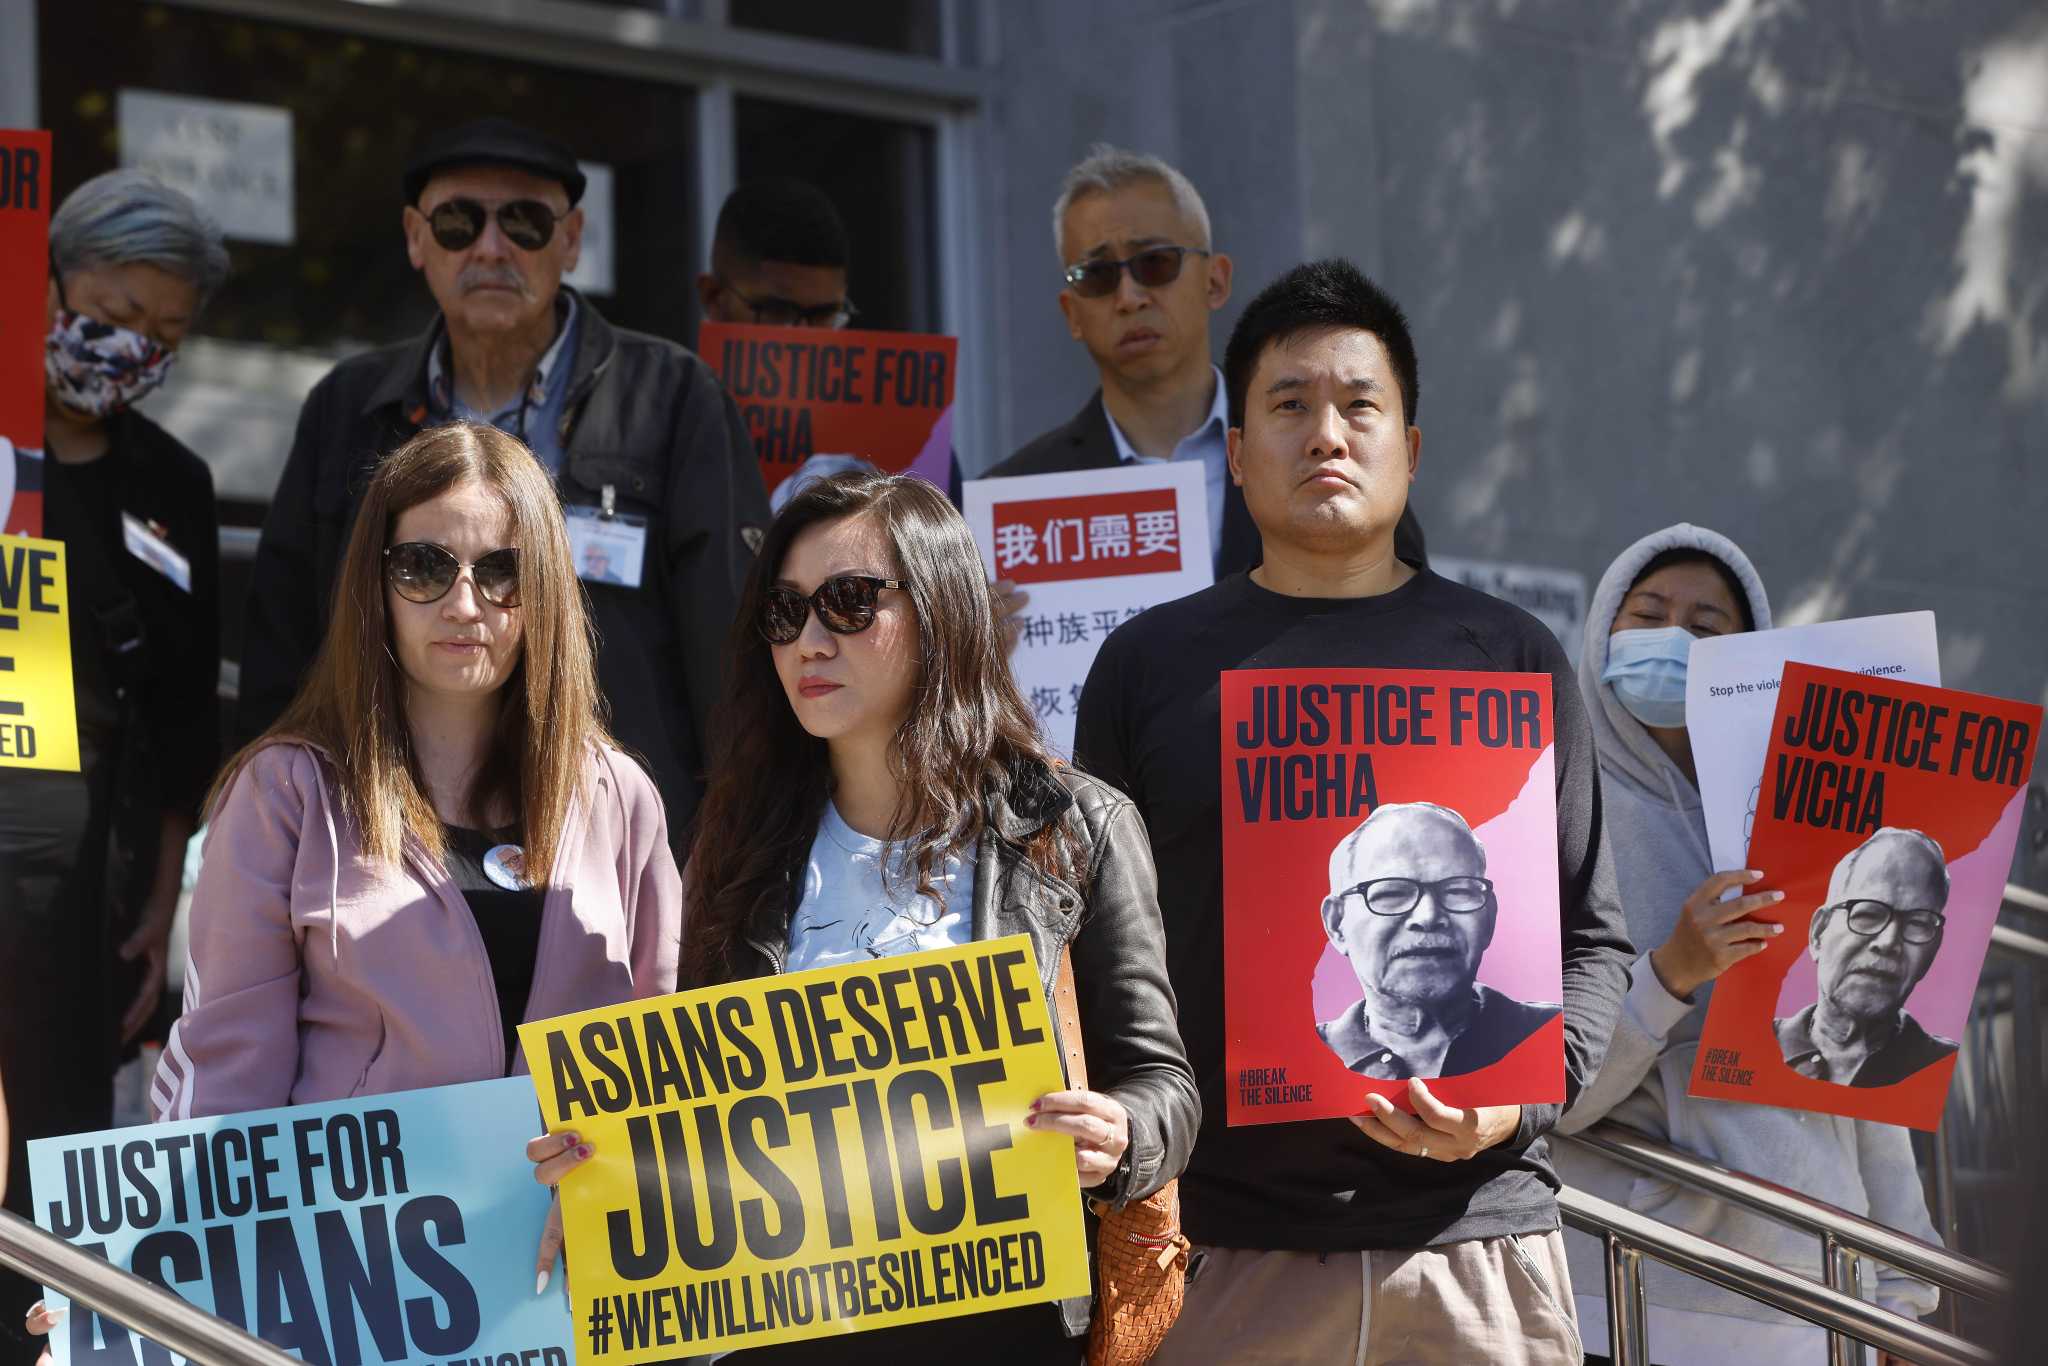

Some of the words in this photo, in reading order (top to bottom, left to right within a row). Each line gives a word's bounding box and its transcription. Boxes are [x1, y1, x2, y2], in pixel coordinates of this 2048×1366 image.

[721, 339, 865, 404] JUSTICE
[873, 348, 947, 408] FOR
[742, 404, 814, 464] CHA
[995, 509, 1178, 569] 我们需要
[1023, 606, 1146, 648] 种族平
[1236, 683, 1437, 751] JUSTICE
[1449, 686, 1542, 750] FOR
[1709, 686, 1734, 697] Stop
[1736, 682, 1754, 694] the
[1756, 678, 1782, 690] viole
[1782, 681, 1950, 773] JUSTICE
[1948, 710, 2031, 788] FOR
[1235, 752, 1380, 824] VICHA
[1772, 752, 1886, 836] VICHA
[544, 994, 768, 1123] ASIANS
[764, 949, 1045, 1085] DESERVE
[1239, 1067, 1287, 1088] #BREAK
[1239, 1087, 1262, 1106] THE
[1264, 1084, 1313, 1105] SILENCE
[1702, 1064, 1717, 1082] THE
[1718, 1066, 1755, 1087] SILENCE
[48, 1122, 289, 1240] JUSTICE
[292, 1108, 410, 1202] FOR
[606, 1057, 1030, 1282] JUSTICE
[588, 1230, 1047, 1357] #WEWILLNOTBESILENCED
